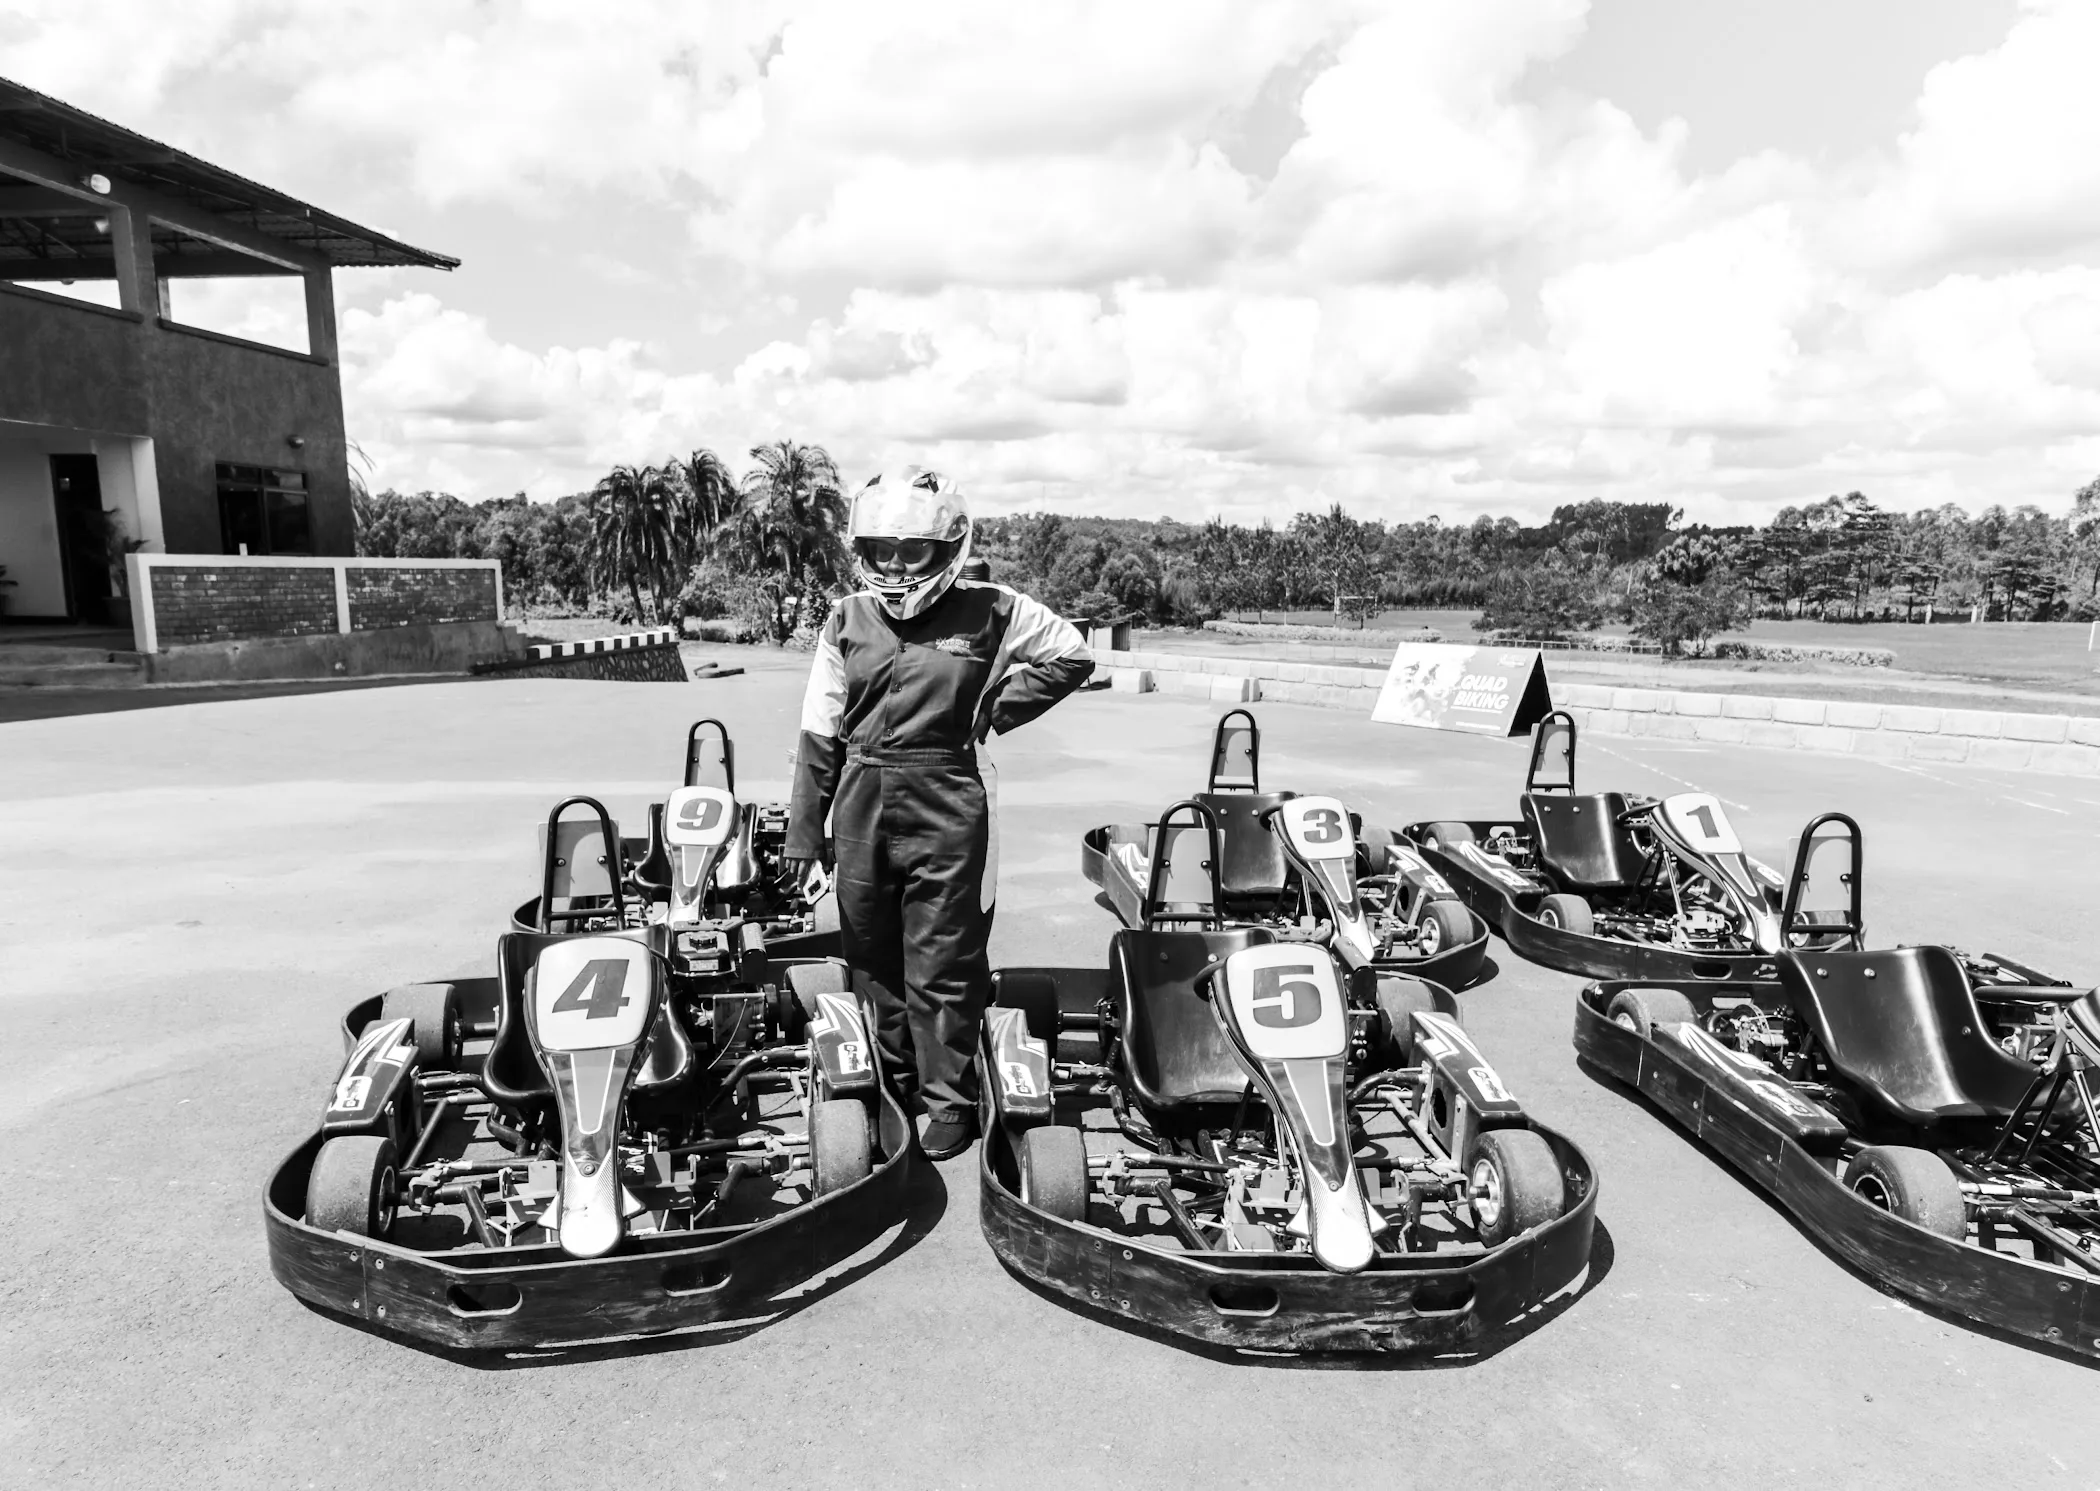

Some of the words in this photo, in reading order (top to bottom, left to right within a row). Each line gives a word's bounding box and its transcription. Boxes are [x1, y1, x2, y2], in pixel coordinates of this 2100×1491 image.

[1461, 674, 1508, 691] QUAD
[1453, 690, 1510, 710] BIKING
[676, 797, 723, 830] 9
[1302, 808, 1343, 844] 3
[1687, 805, 1720, 838] 1
[552, 959, 630, 1019] 4
[1252, 965, 1322, 1028] 5
